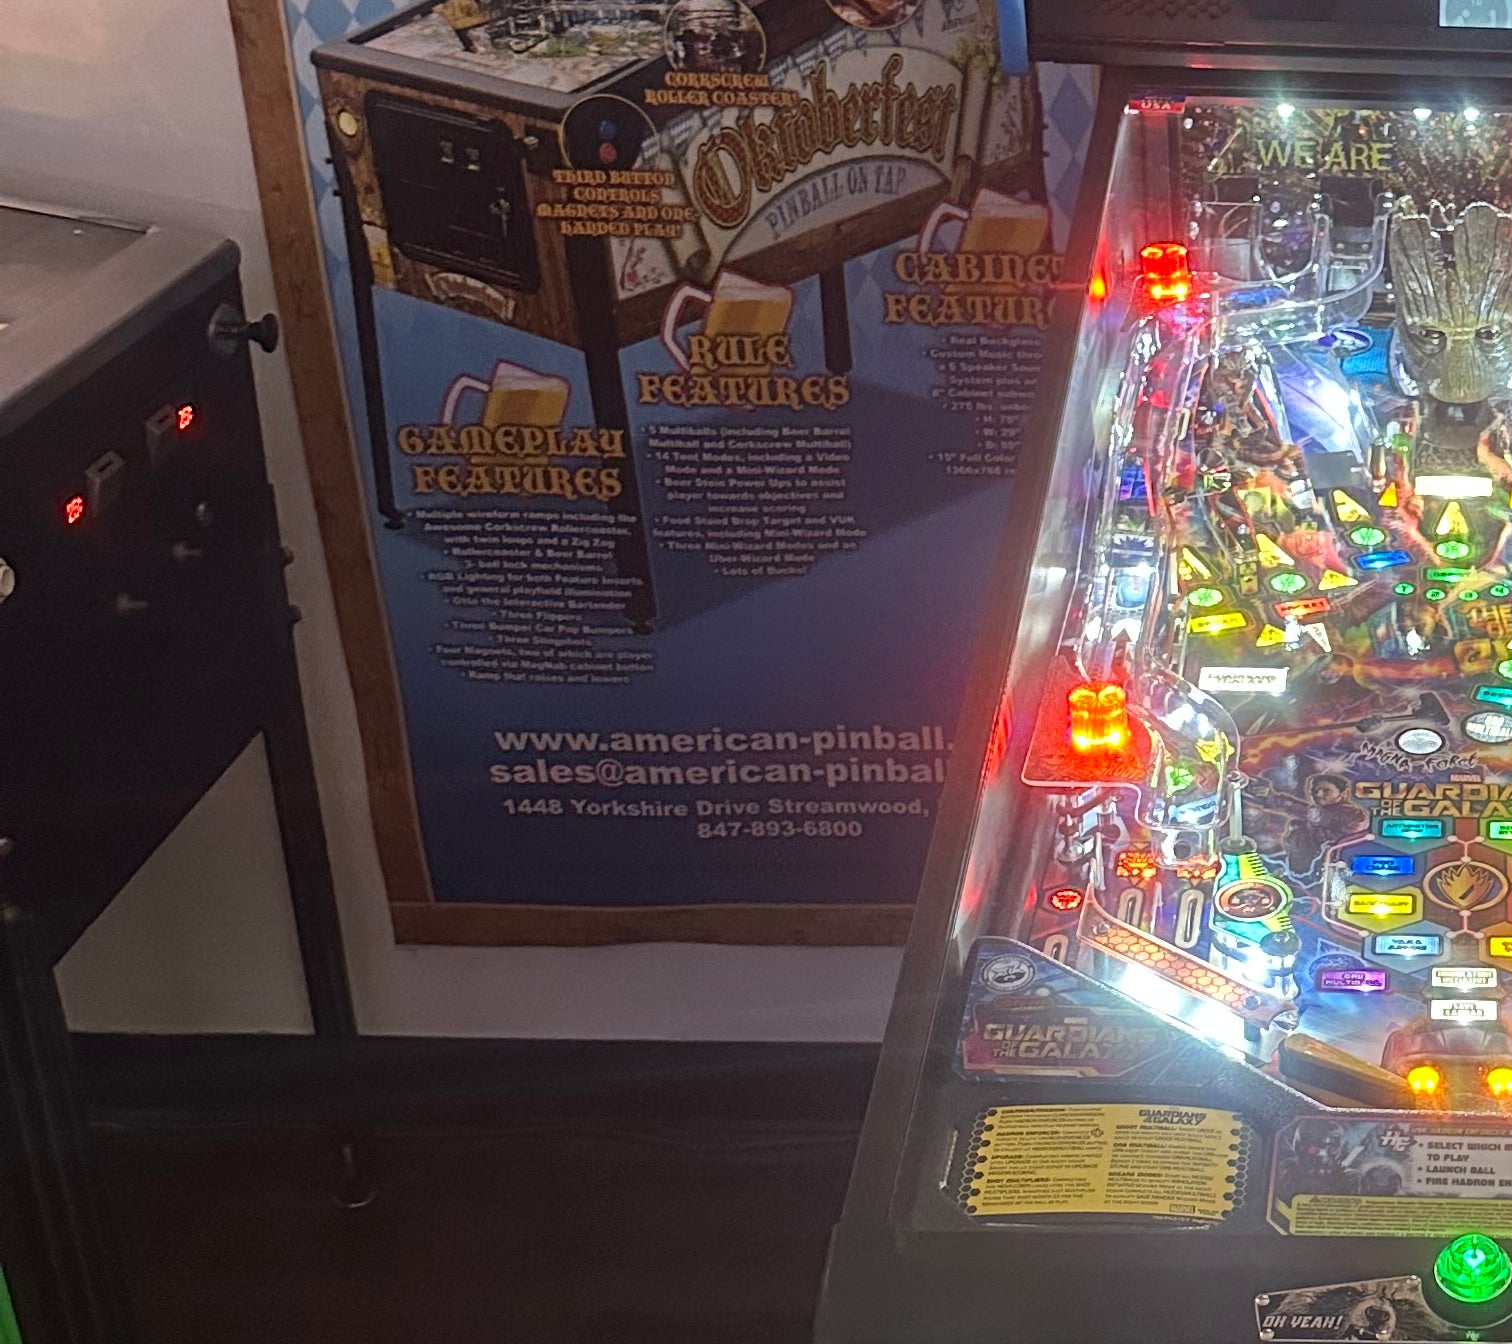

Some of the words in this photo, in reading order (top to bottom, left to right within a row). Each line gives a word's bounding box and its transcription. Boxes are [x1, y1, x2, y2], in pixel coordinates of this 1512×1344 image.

[664, 72, 770, 88] CORKSCREW
[646, 89, 707, 106] ROLLER
[711, 89, 798, 108] COASTER!
[697, 53, 959, 228] Oktoberfest
[1258, 140, 1316, 168] WE
[1324, 142, 1395, 171] ARE
[553, 170, 604, 187] THIRD
[607, 171, 674, 187] BUTTON
[573, 187, 662, 204] CONTROLS
[769, 175, 846, 238] PINBALL
[848, 167, 873, 198] ON
[536, 205, 618, 221] MAGNETS
[620, 205, 659, 221] AND
[661, 205, 695, 222] ONE
[559, 222, 626, 238] HANDED
[689, 334, 792, 367] RULE
[638, 375, 850, 410] FEATURES
[400, 427, 624, 459] GAMEPLAY
[414, 466, 622, 498] FEATURES
[503, 799, 562, 815] 1448
[570, 799, 688, 817] Yorkshire
[696, 798, 760, 816] Drive
[768, 798, 931, 818] Streamwood,
[1372, 807, 1402, 817] THE
[1427, 1141, 1464, 1151] SELECT
[1467, 1142, 1501, 1152] WHICH
[1427, 1153, 1441, 1162] TO
[1443, 1153, 1470, 1162] PLAY
[1425, 1165, 1467, 1174] LAUNCH
[1470, 1166, 1497, 1175] BALL
[1425, 1177, 1449, 1186] FIRE
[1452, 1177, 1496, 1187] HADRON
[1262, 1316, 1284, 1329] OH
[1290, 1316, 1343, 1331] YEAH!
